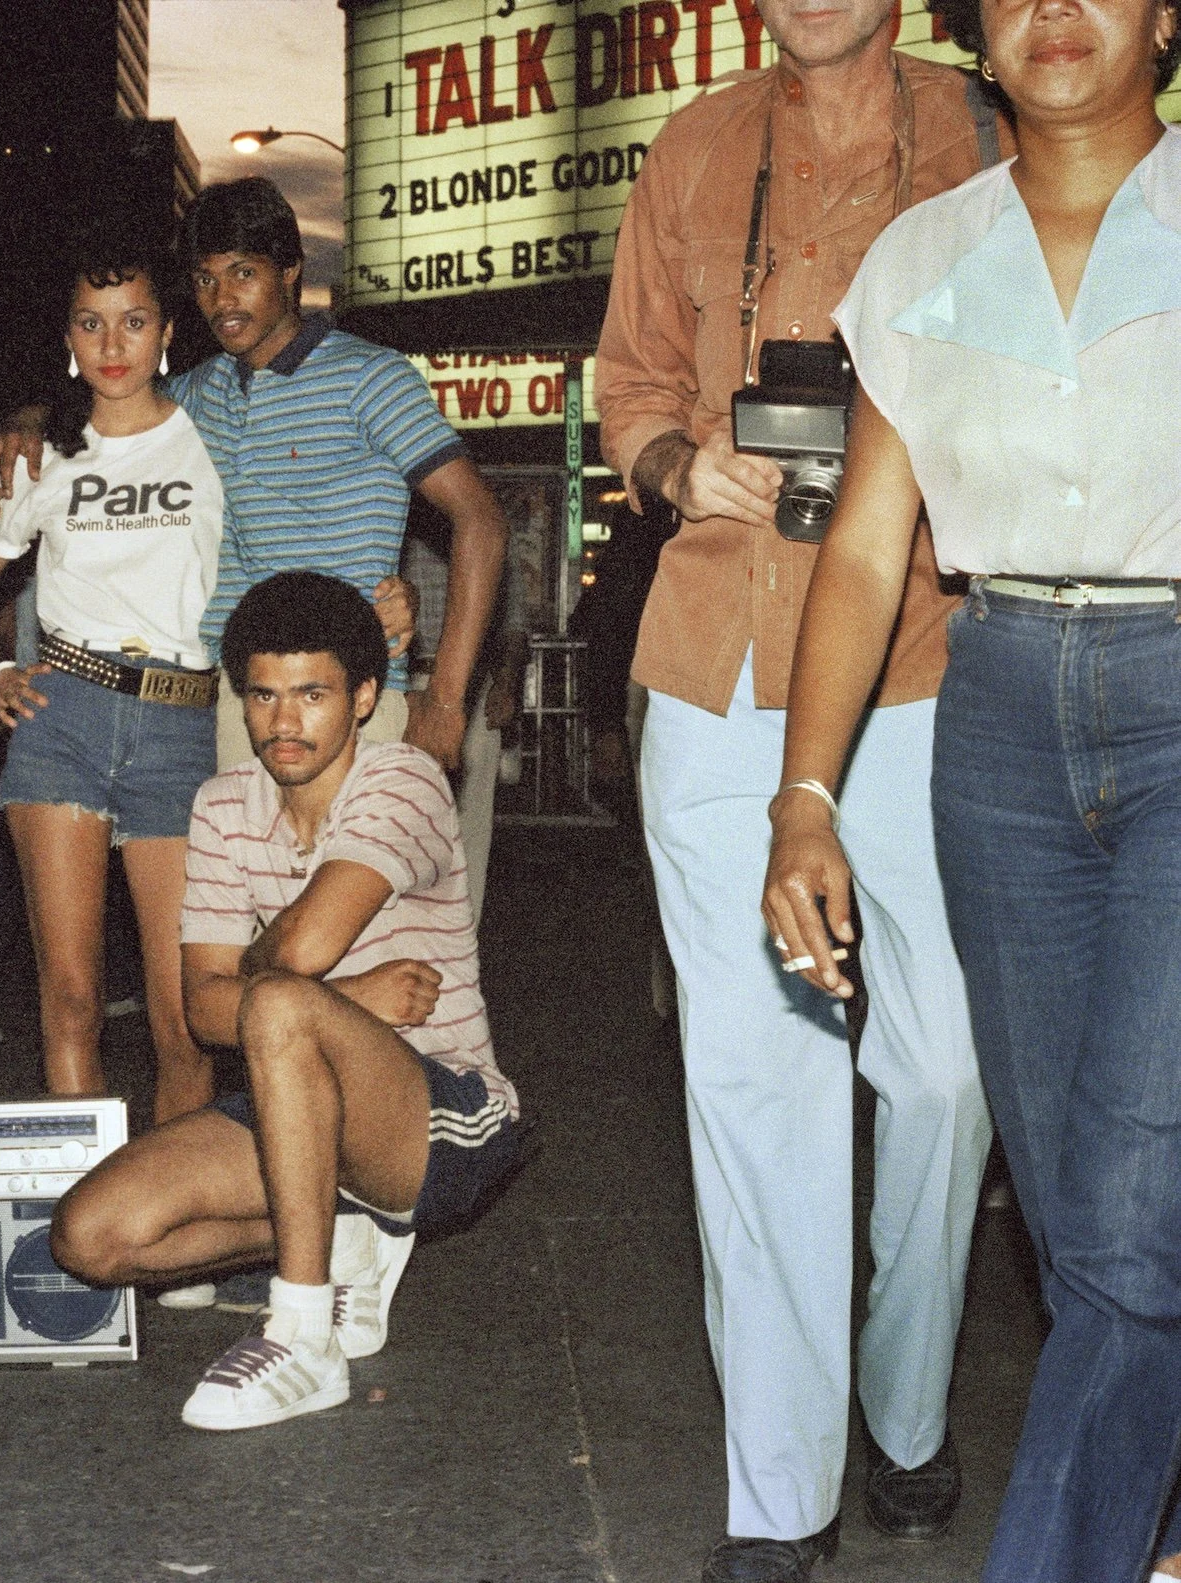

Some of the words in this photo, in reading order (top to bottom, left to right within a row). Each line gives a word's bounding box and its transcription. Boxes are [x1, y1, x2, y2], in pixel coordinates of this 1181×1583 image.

[404, 22, 557, 137] TALK
[575, 0, 765, 109] DIRTY
[379, 184, 397, 219] 2
[409, 159, 538, 216] BLONDE
[404, 245, 495, 293] GIRLS
[511, 229, 599, 280] BEST
[430, 376, 512, 420] TWO
[569, 401, 579, 524] SUBWAY
[65, 518, 104, 533] Swim
[105, 519, 114, 531] &
[116, 515, 158, 531] Health
[160, 513, 192, 527] Club
[67, 473, 194, 517] Parc
